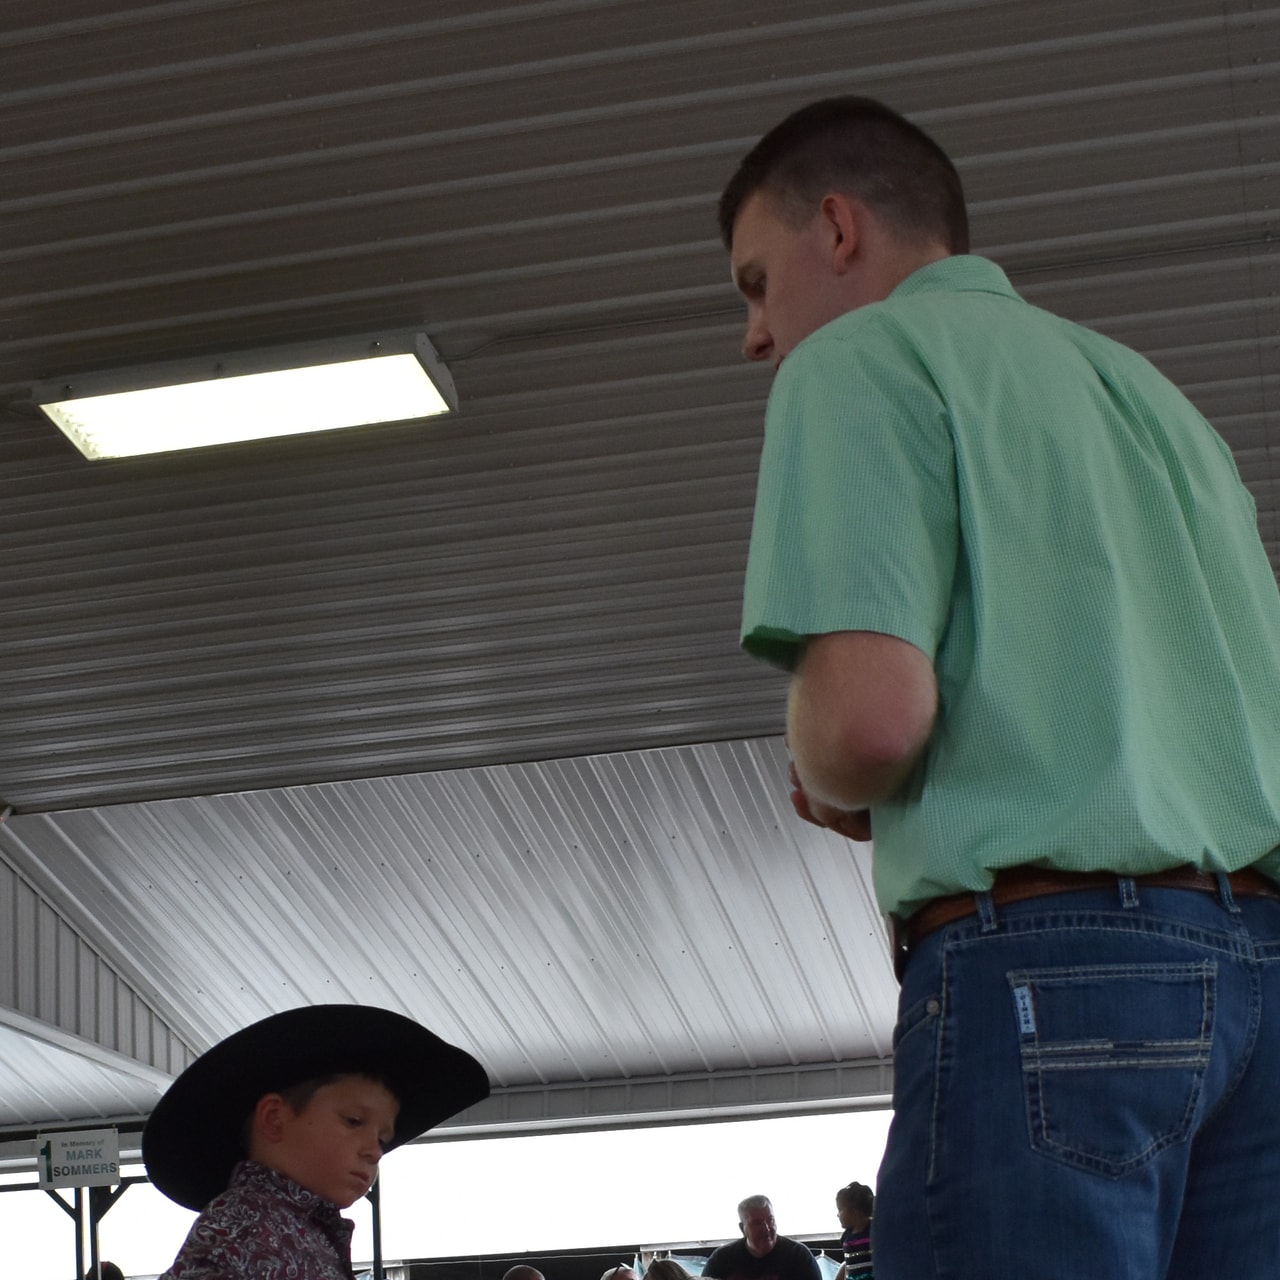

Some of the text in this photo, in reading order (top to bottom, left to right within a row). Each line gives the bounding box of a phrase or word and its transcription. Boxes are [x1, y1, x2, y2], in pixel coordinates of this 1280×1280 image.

[40, 1140, 53, 1182] 1
[66, 1149, 103, 1160] MARK
[53, 1162, 117, 1177] SOMMERS
